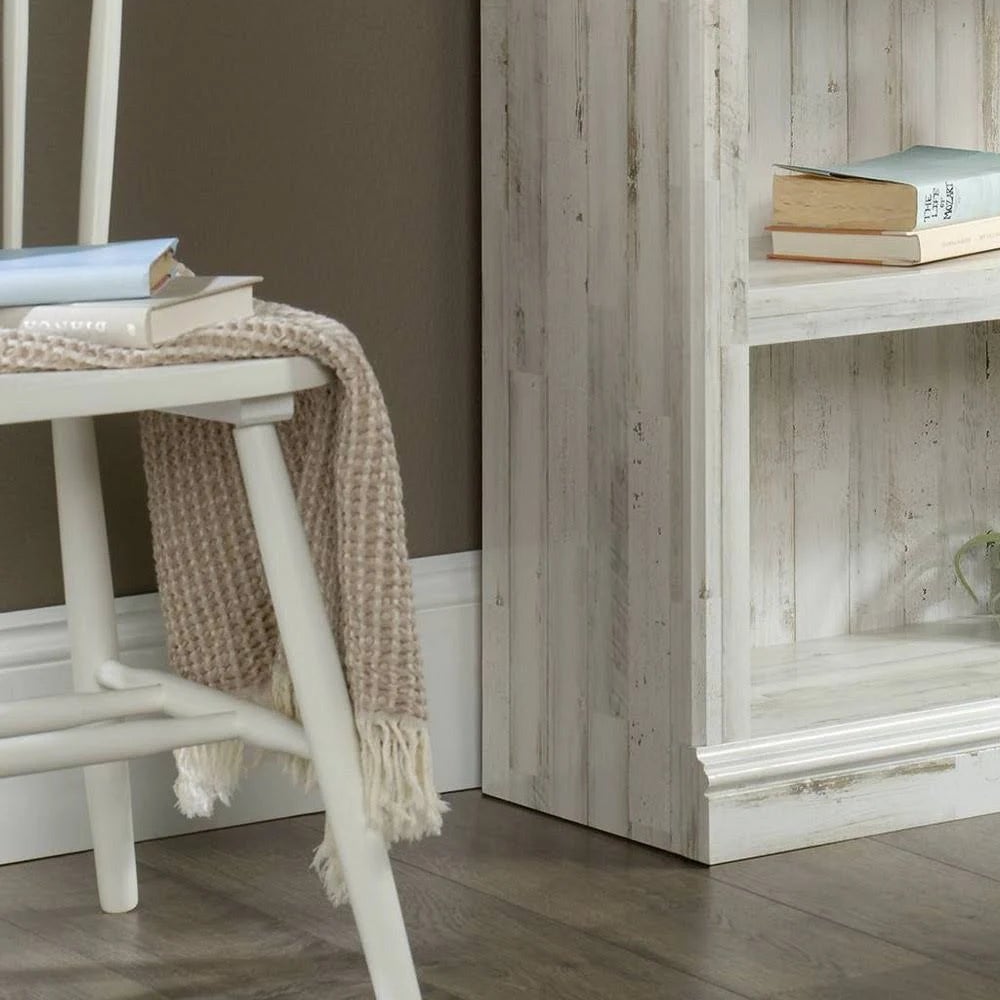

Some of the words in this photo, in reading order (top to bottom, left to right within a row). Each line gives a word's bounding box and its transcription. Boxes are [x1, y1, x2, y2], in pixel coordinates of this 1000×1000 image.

[923, 194, 932, 222] THE
[931, 188, 939, 217] LIFE
[943, 181, 954, 220] MOZART
